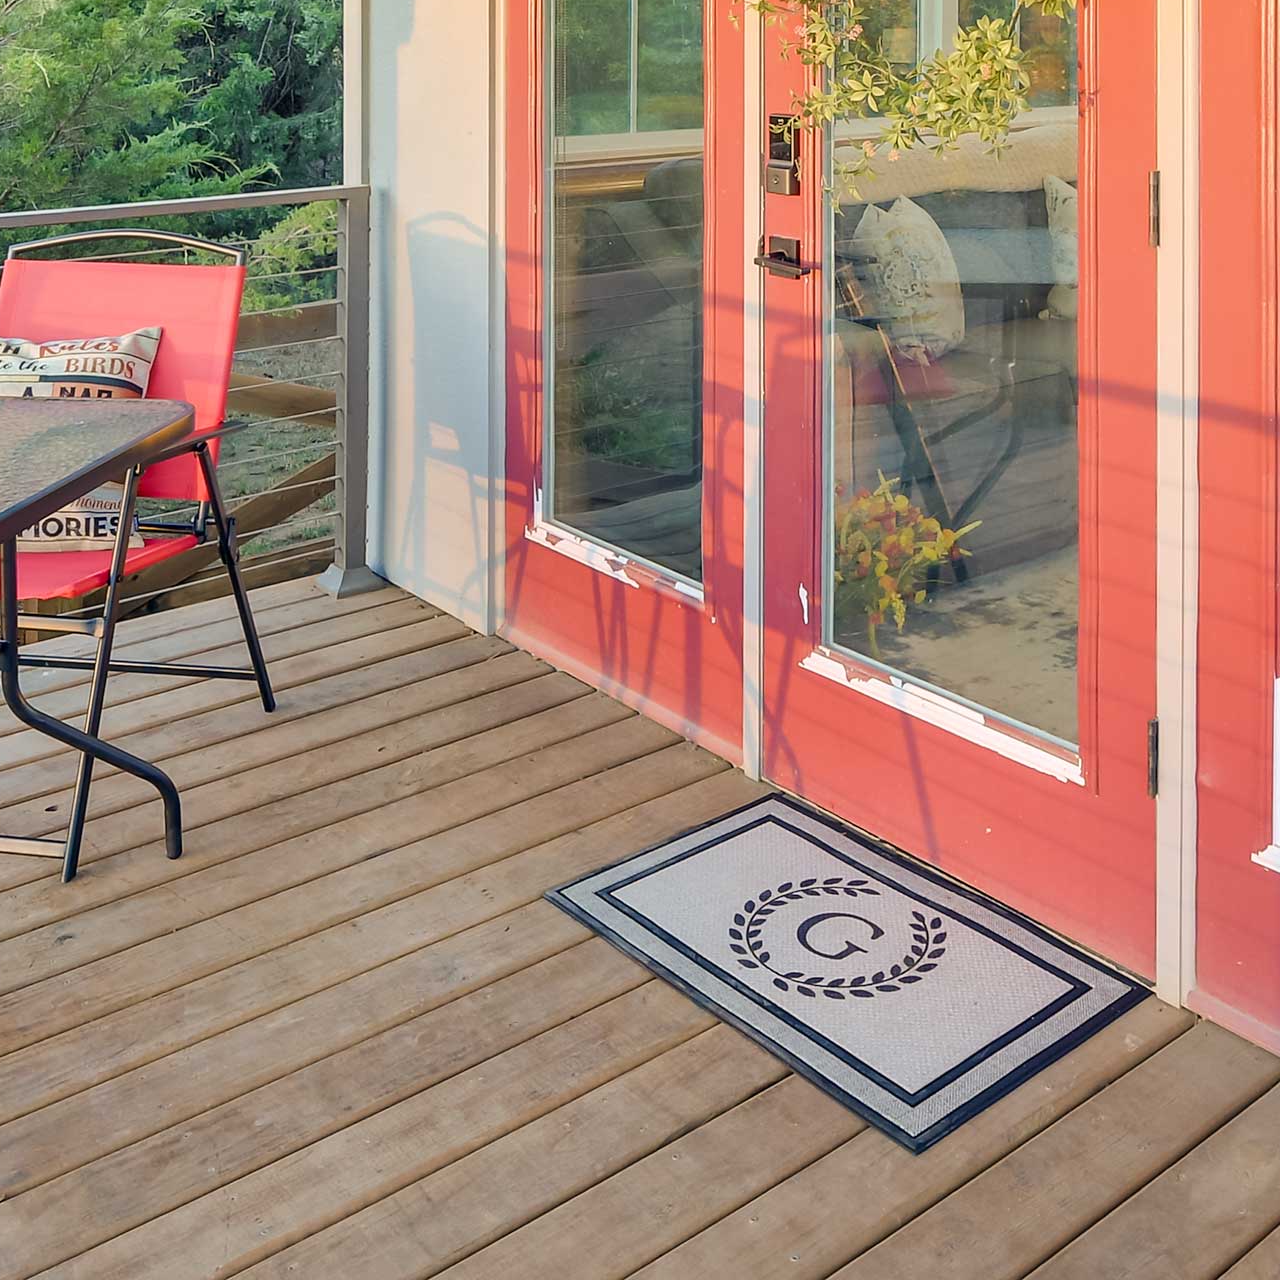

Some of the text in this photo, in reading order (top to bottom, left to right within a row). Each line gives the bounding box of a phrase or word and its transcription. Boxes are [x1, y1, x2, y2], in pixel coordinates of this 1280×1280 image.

[18, 360, 48, 372] the
[64, 357, 136, 380] BIRDS
[796, 912, 885, 960] G
